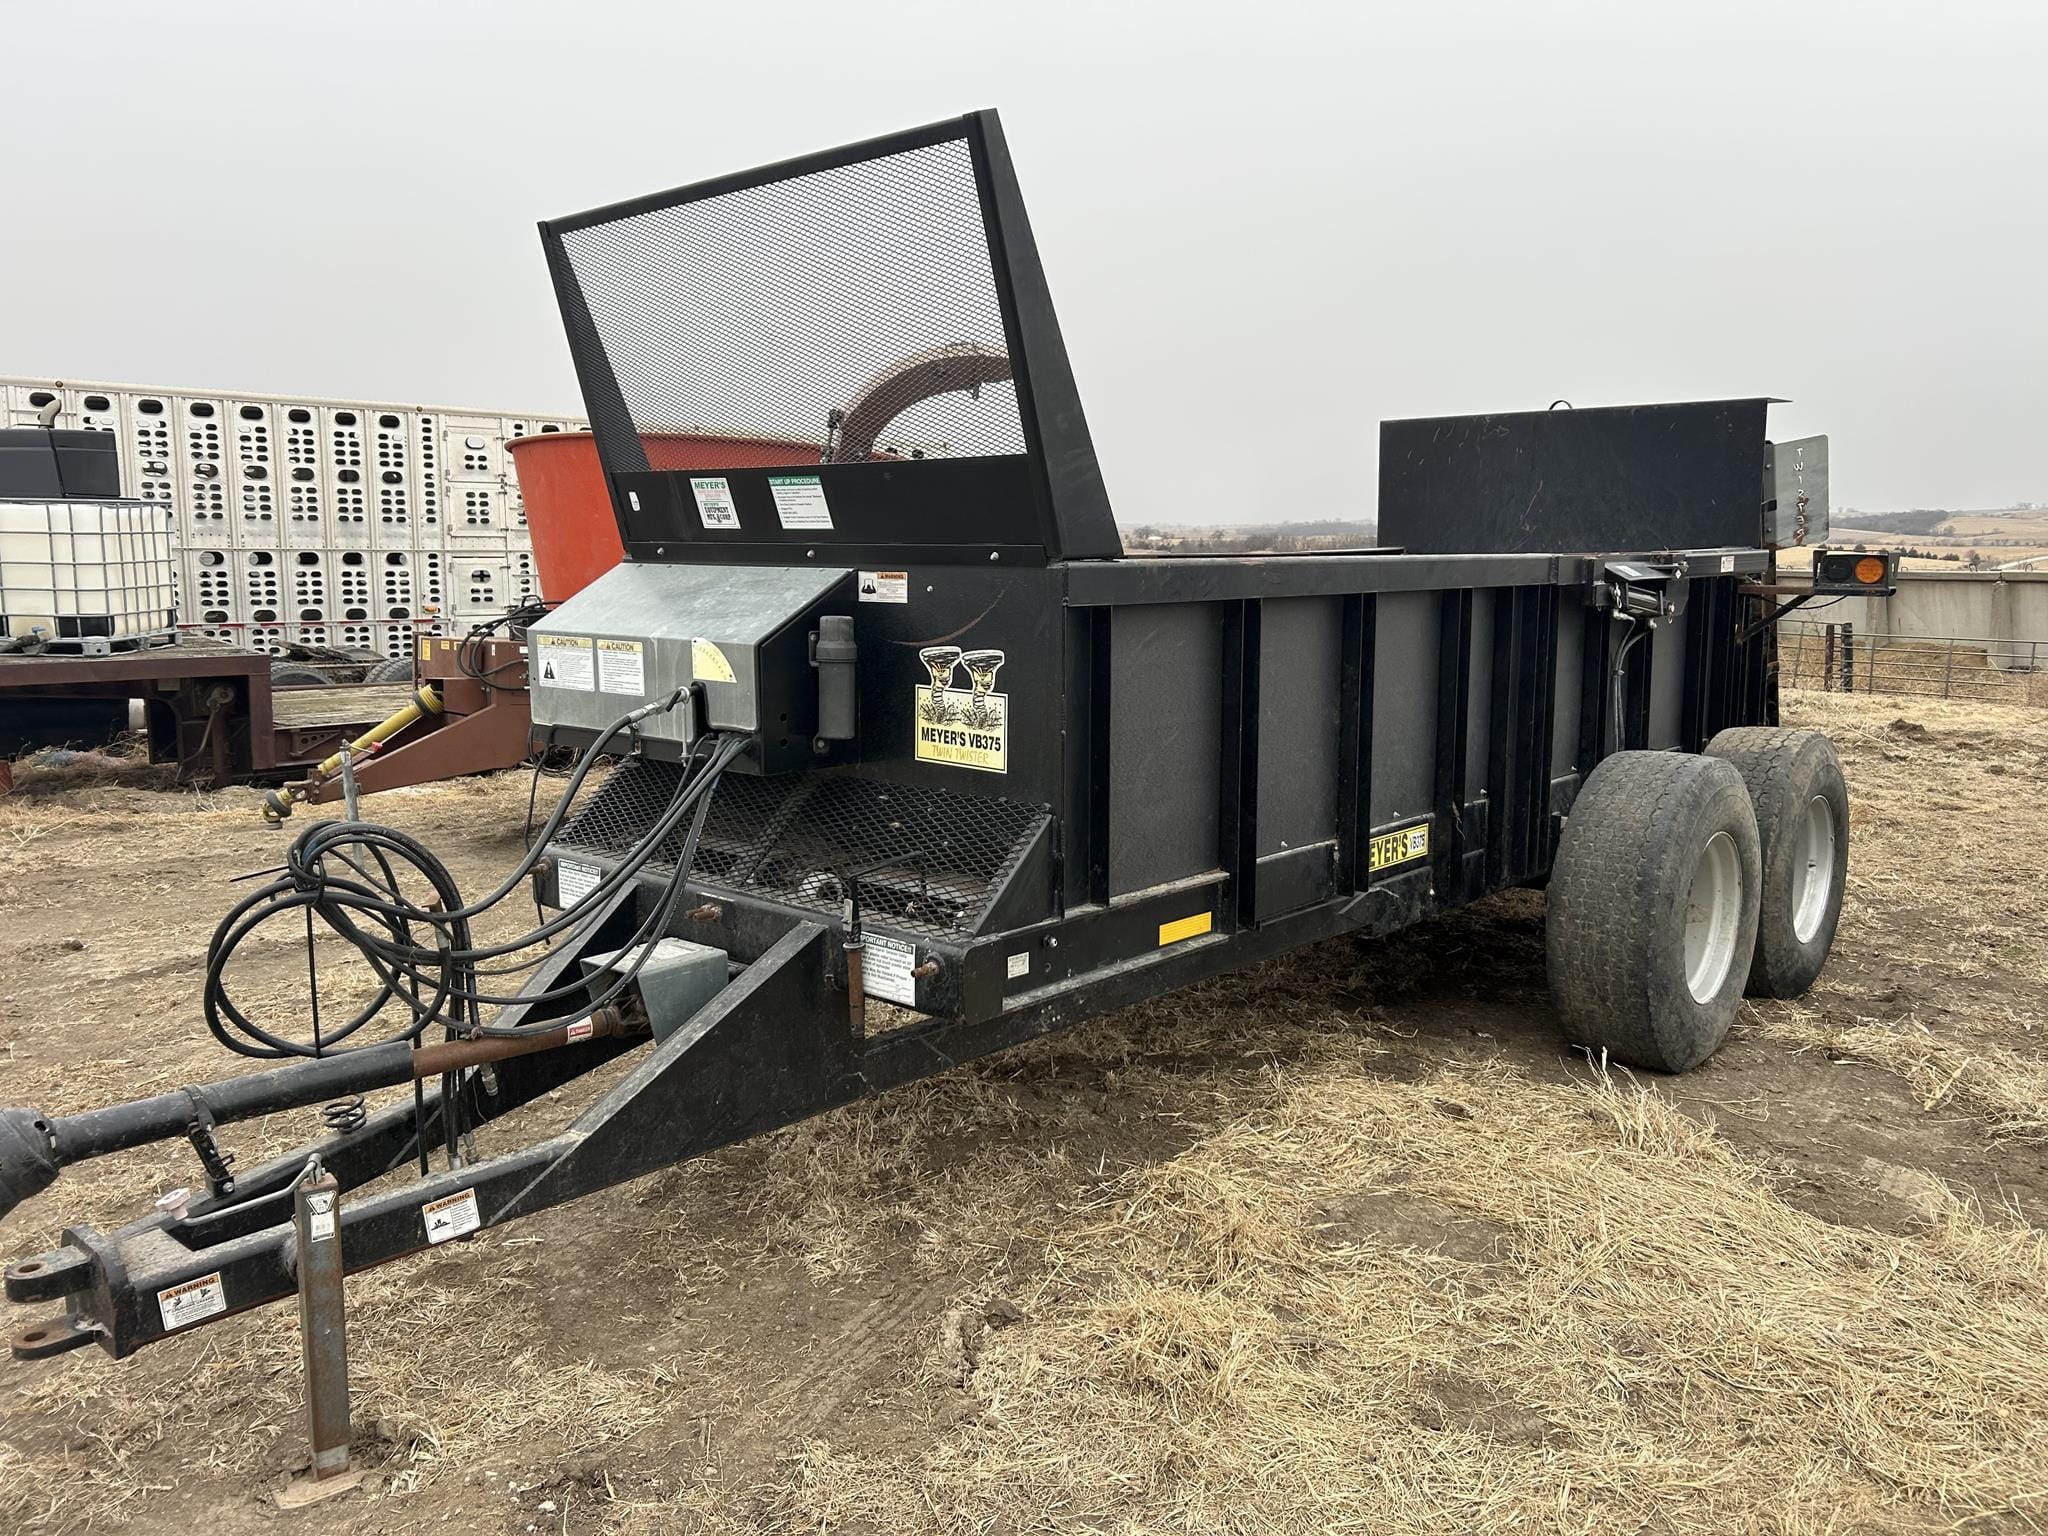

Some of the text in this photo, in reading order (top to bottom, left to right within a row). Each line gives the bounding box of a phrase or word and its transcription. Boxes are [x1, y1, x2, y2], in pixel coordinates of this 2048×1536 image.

[694, 481, 726, 490] MEYER'S
[791, 477, 822, 485] PROCEDURE
[556, 638, 579, 647] CAUTION
[611, 642, 634, 651] CAUTION
[921, 727, 1001, 751] MEYER'S VB375
[931, 745, 989, 765] TWIN TWISTER
[1369, 833, 1409, 868] EYER'S
[435, 1192, 471, 1210] WARNING
[173, 1277, 215, 1297] WARNING
